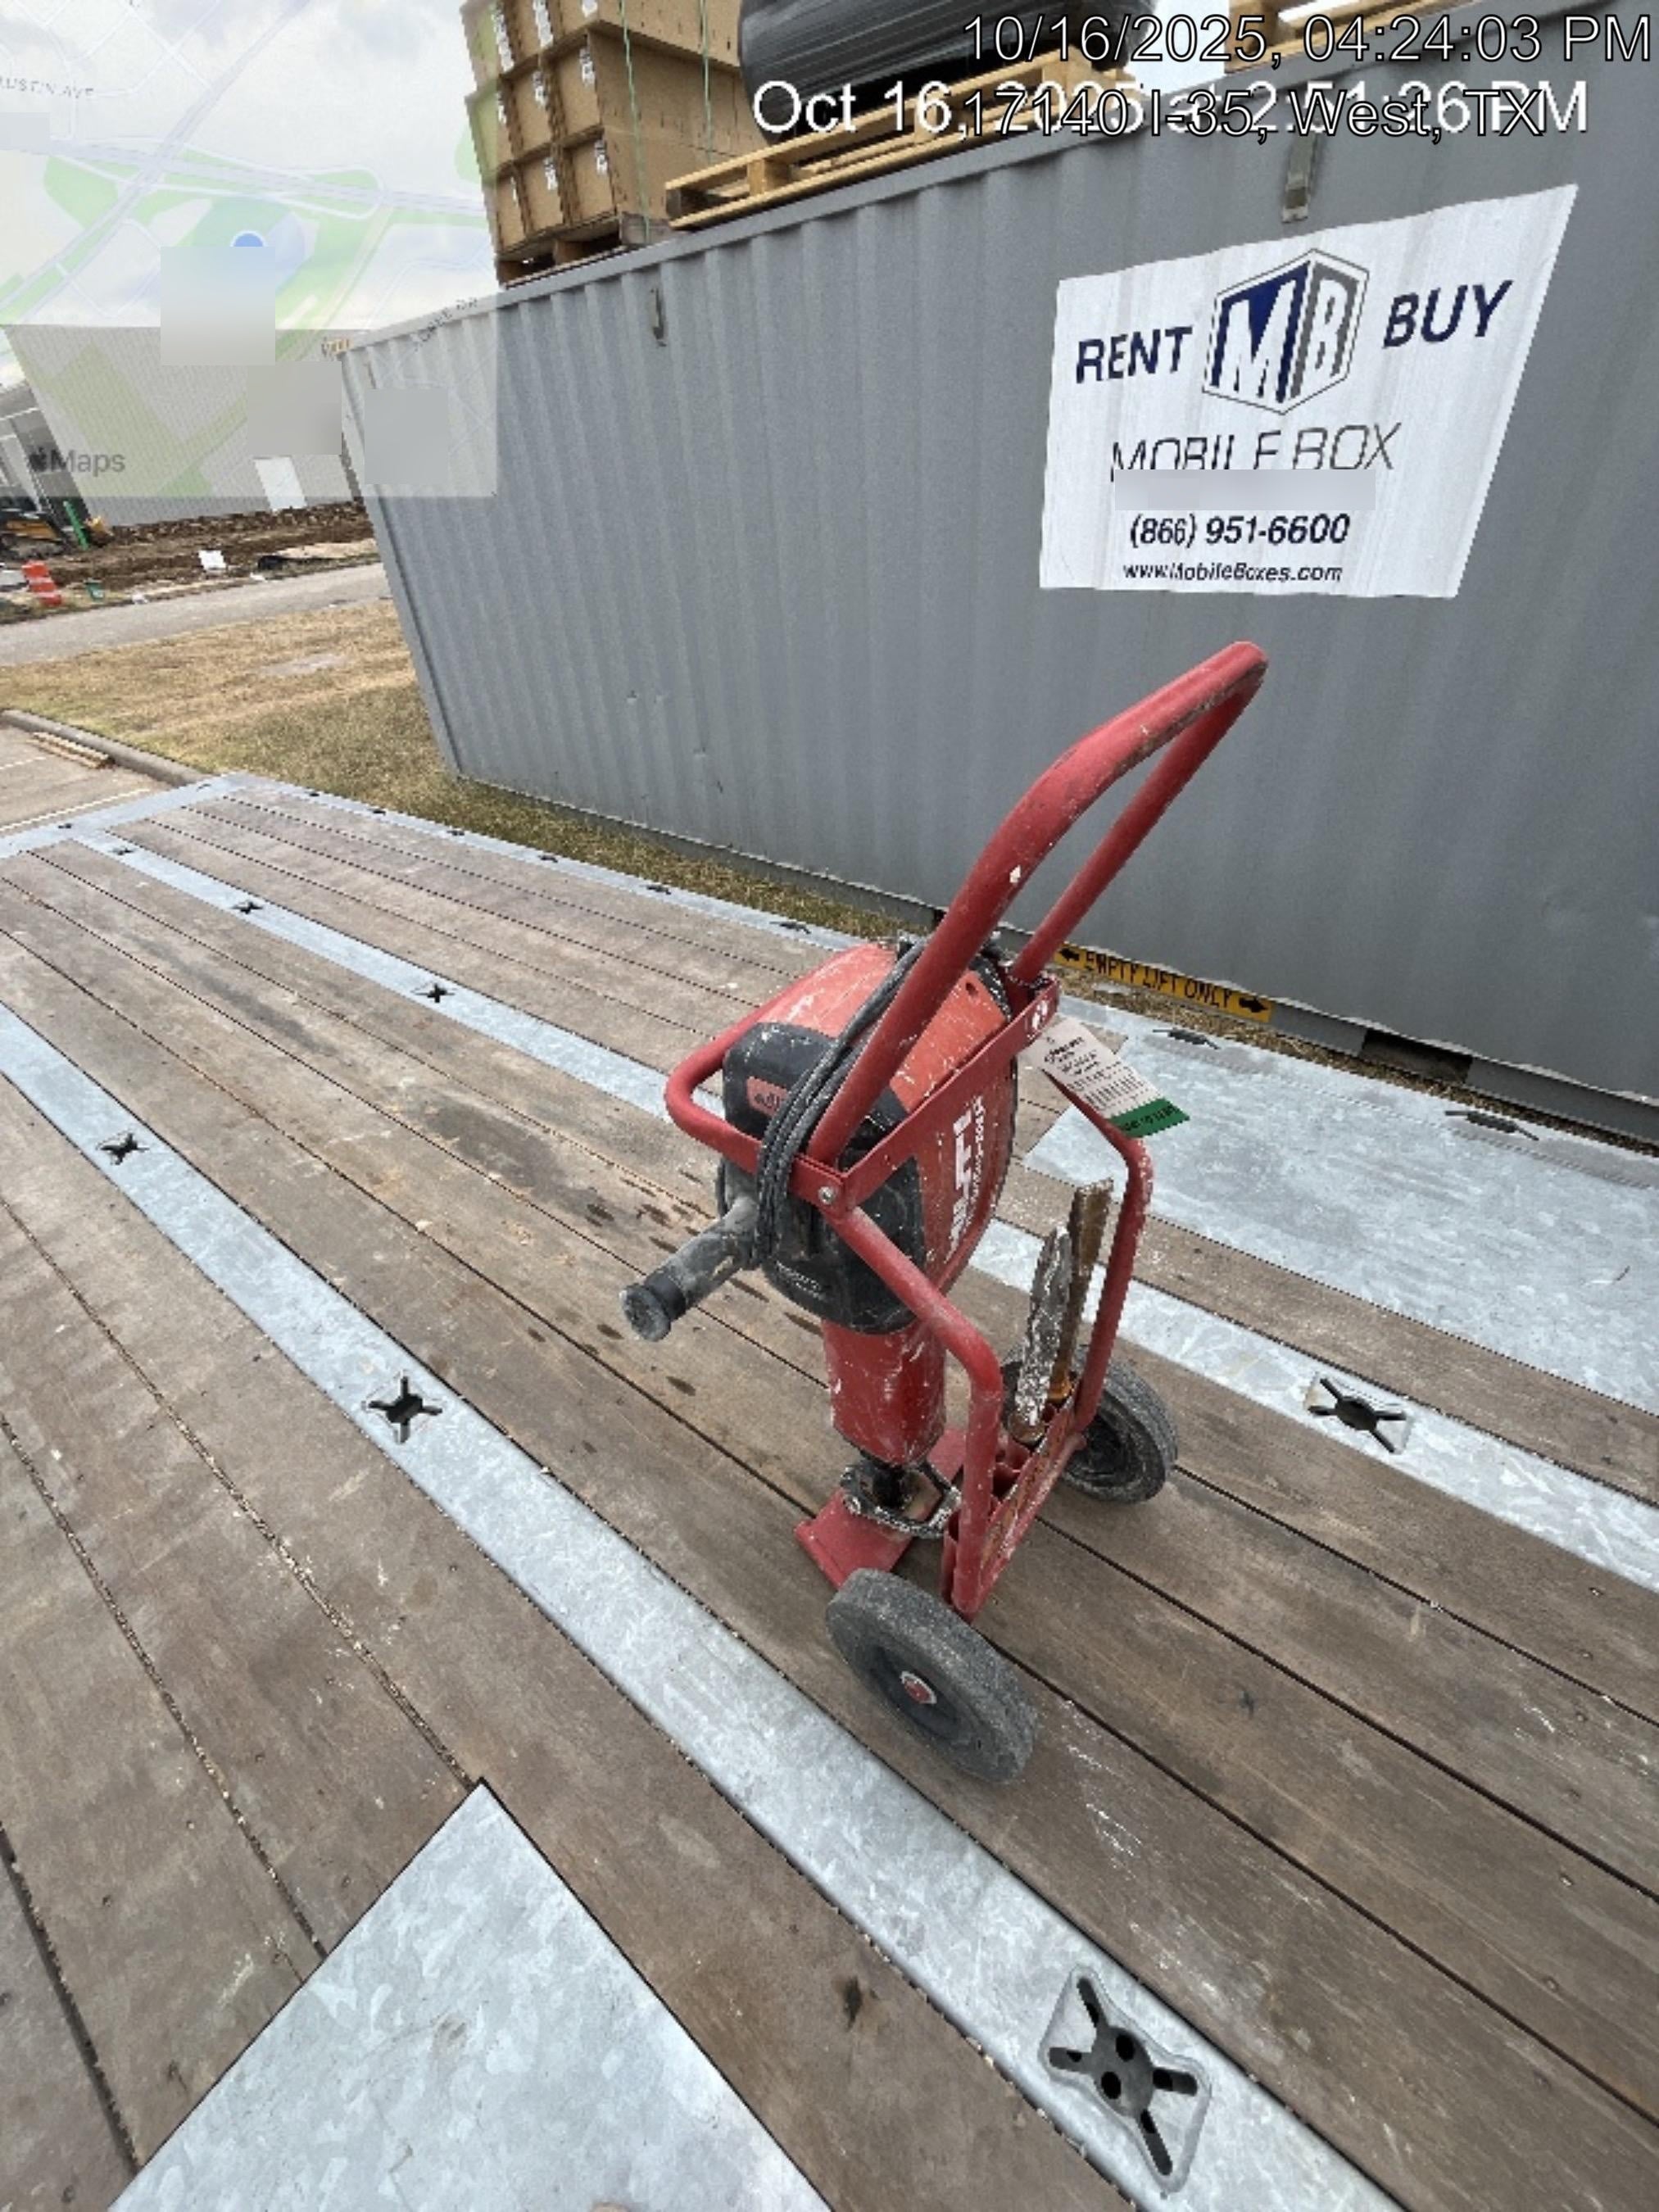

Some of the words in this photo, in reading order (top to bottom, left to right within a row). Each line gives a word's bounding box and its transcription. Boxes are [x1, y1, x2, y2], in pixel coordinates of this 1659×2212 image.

[1076, 326, 1193, 383] RENT
[1382, 280, 1514, 349] BUY
[1292, 422, 1403, 471] BOX
[1130, 513, 1197, 548] (866)
[1205, 513, 1351, 545] 951-6600
